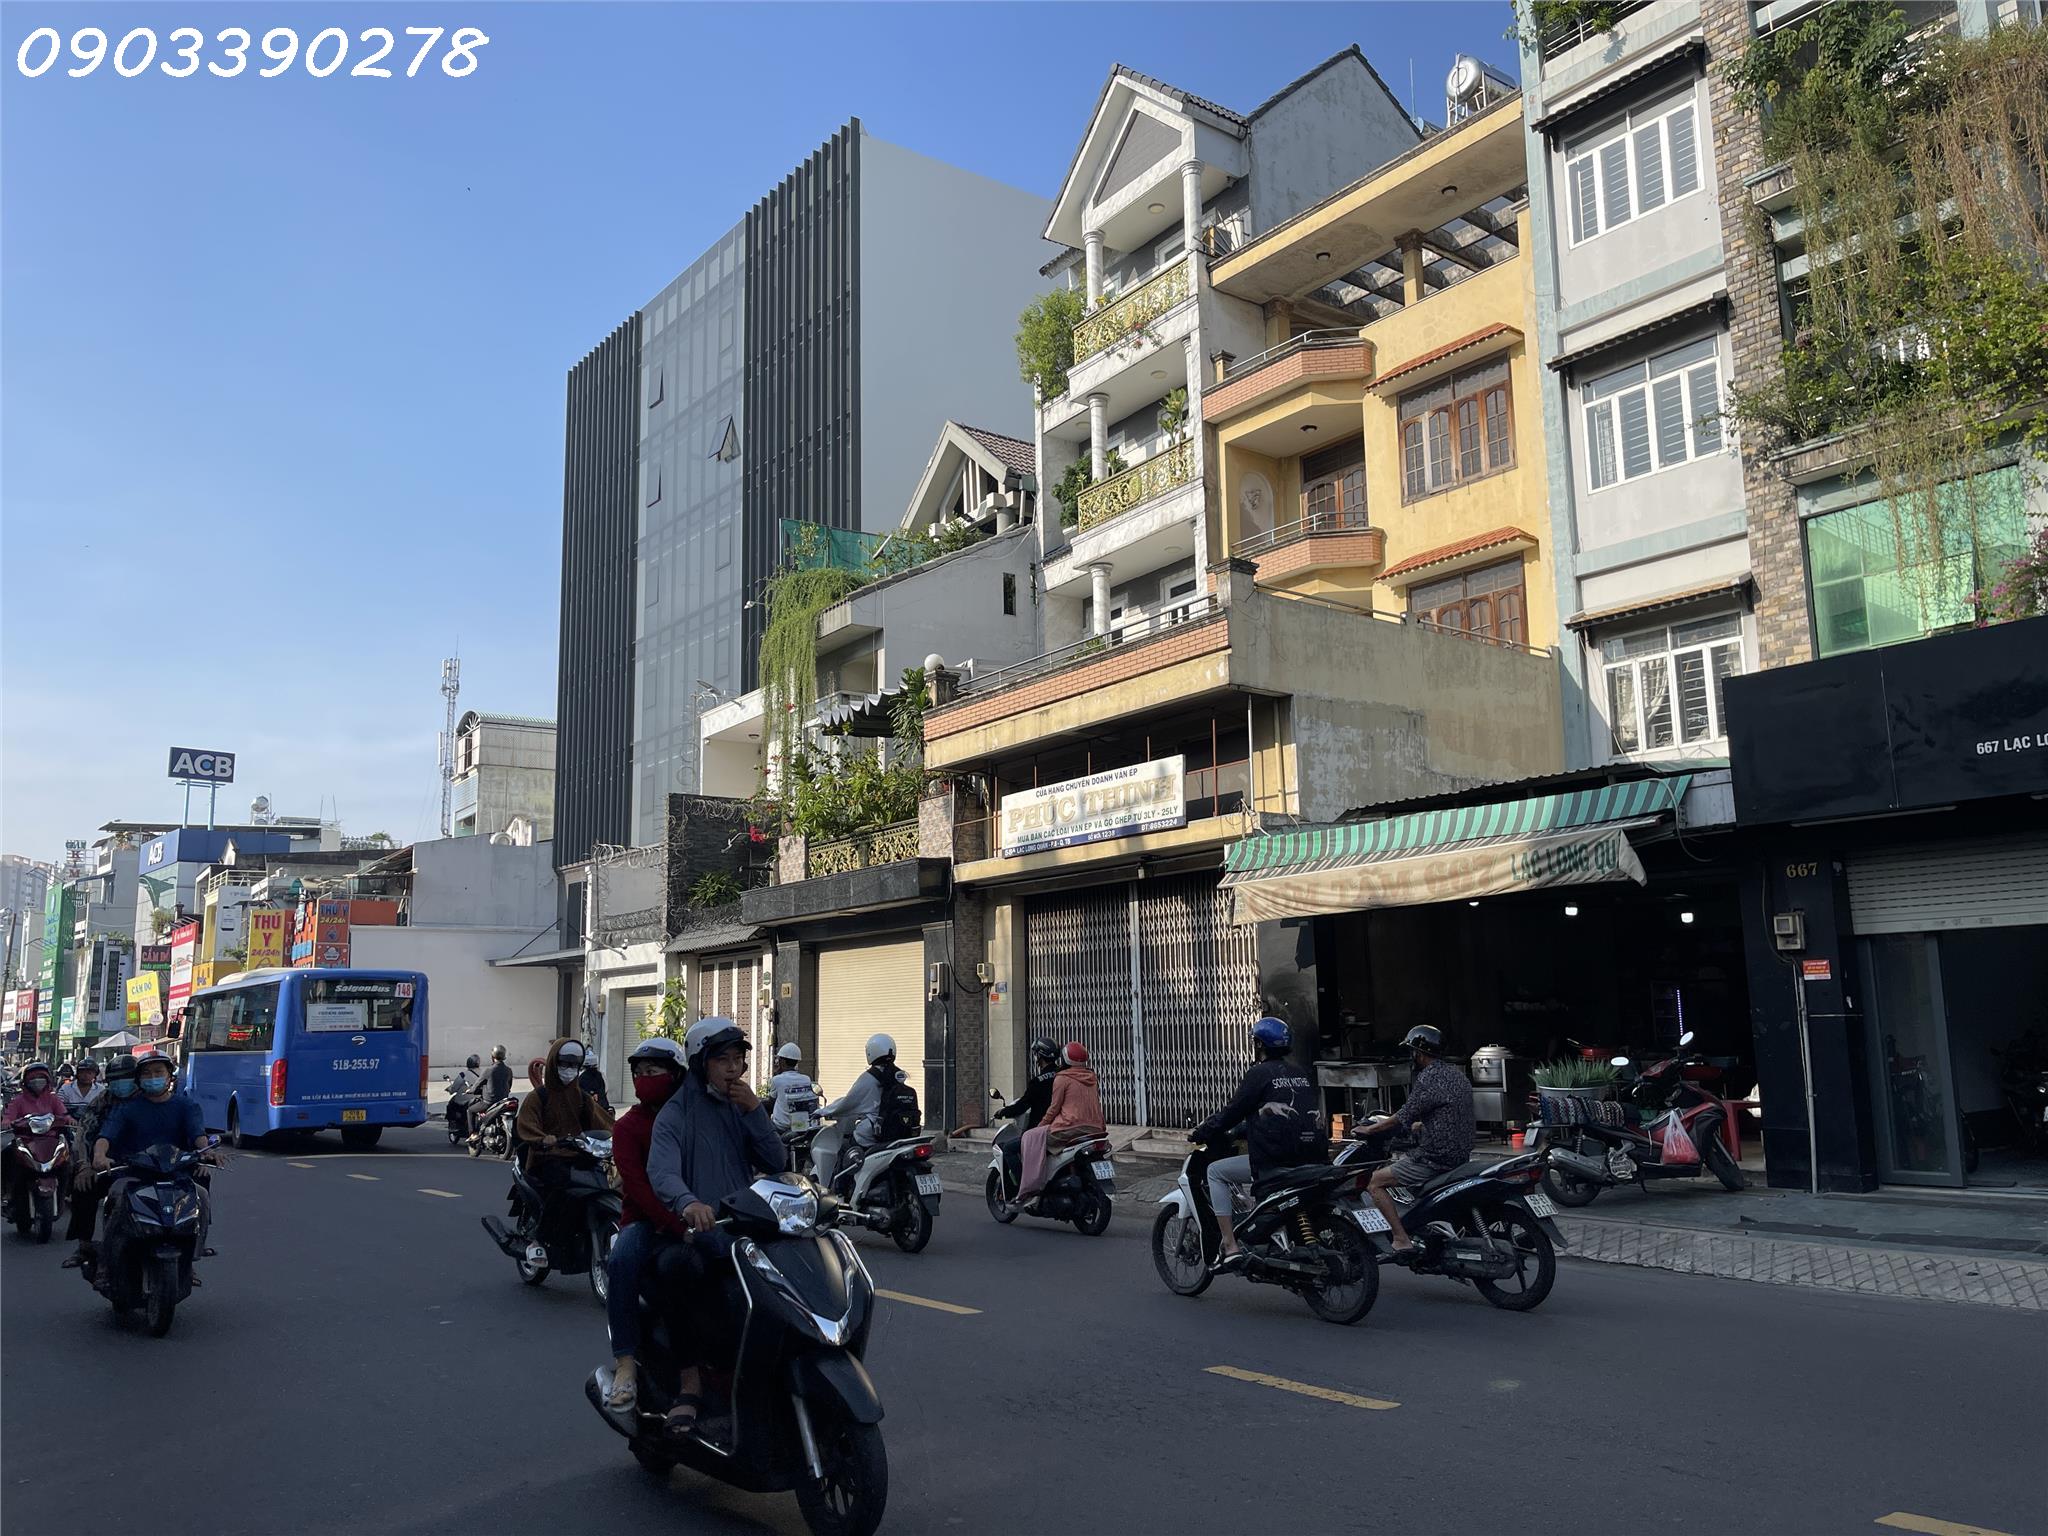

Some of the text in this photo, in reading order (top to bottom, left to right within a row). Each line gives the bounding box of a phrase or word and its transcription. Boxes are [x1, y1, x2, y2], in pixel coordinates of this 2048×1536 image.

[1976, 740, 1999, 755] 667
[2004, 736, 2031, 752] LẠC
[172, 752, 233, 778] ACB
[1092, 775, 1114, 785] DOANH
[1084, 774, 1177, 817] THỊNH
[1017, 834, 1030, 844] MUA
[1162, 806, 1178, 816] 25LY
[148, 841, 164, 866] ACB
[1511, 851, 1542, 884] LẠC
[1549, 843, 1590, 875] LONG
[1786, 862, 1818, 878] 667
[253, 911, 281, 930] THÚ
[334, 984, 391, 993] SaigonBus
[397, 984, 412, 997] 148
[332, 1058, 380, 1071] 51B-255.97
